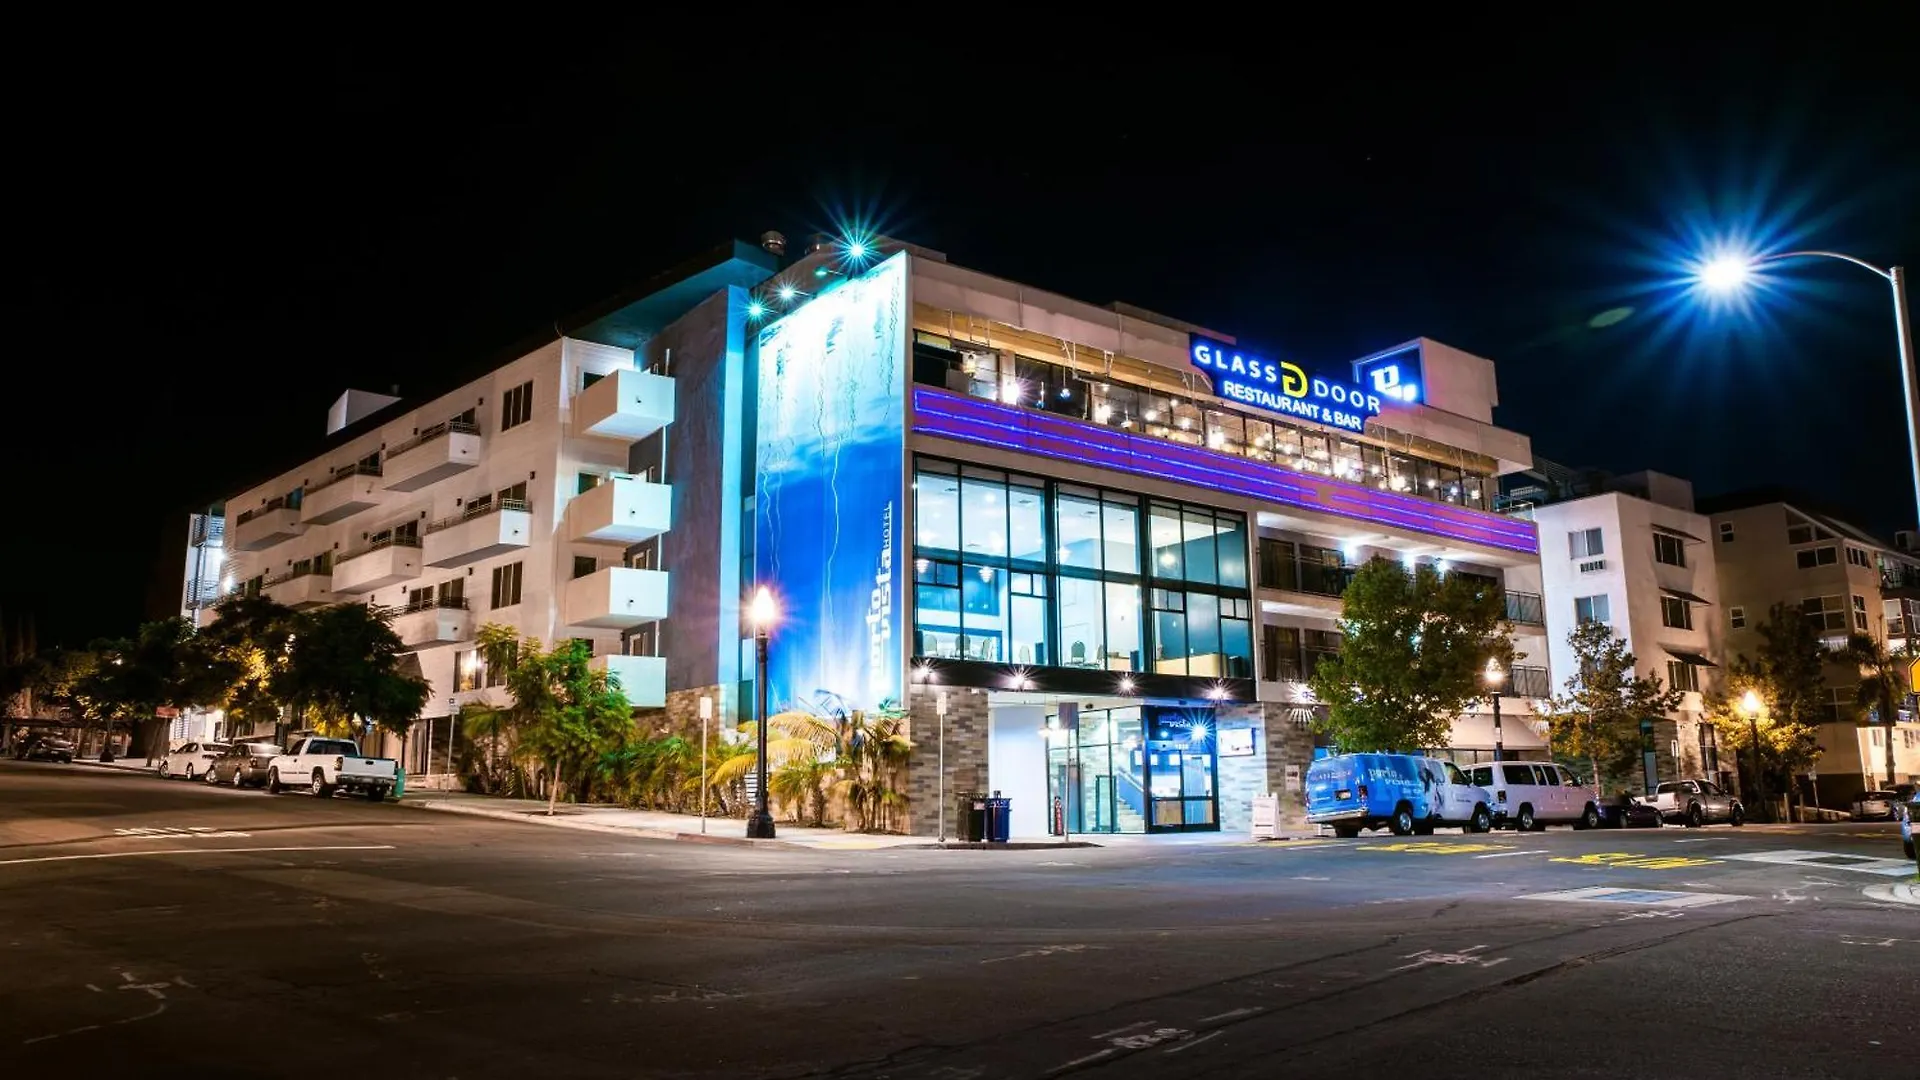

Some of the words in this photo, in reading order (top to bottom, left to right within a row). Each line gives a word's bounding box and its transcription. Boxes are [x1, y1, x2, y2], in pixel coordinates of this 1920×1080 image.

[1194, 345, 1277, 383] GLASS
[1314, 379, 1380, 413] DOOR
[1223, 380, 1320, 418] RESTAURANT
[1322, 408, 1333, 422] &
[1334, 411, 1361, 430] BAR
